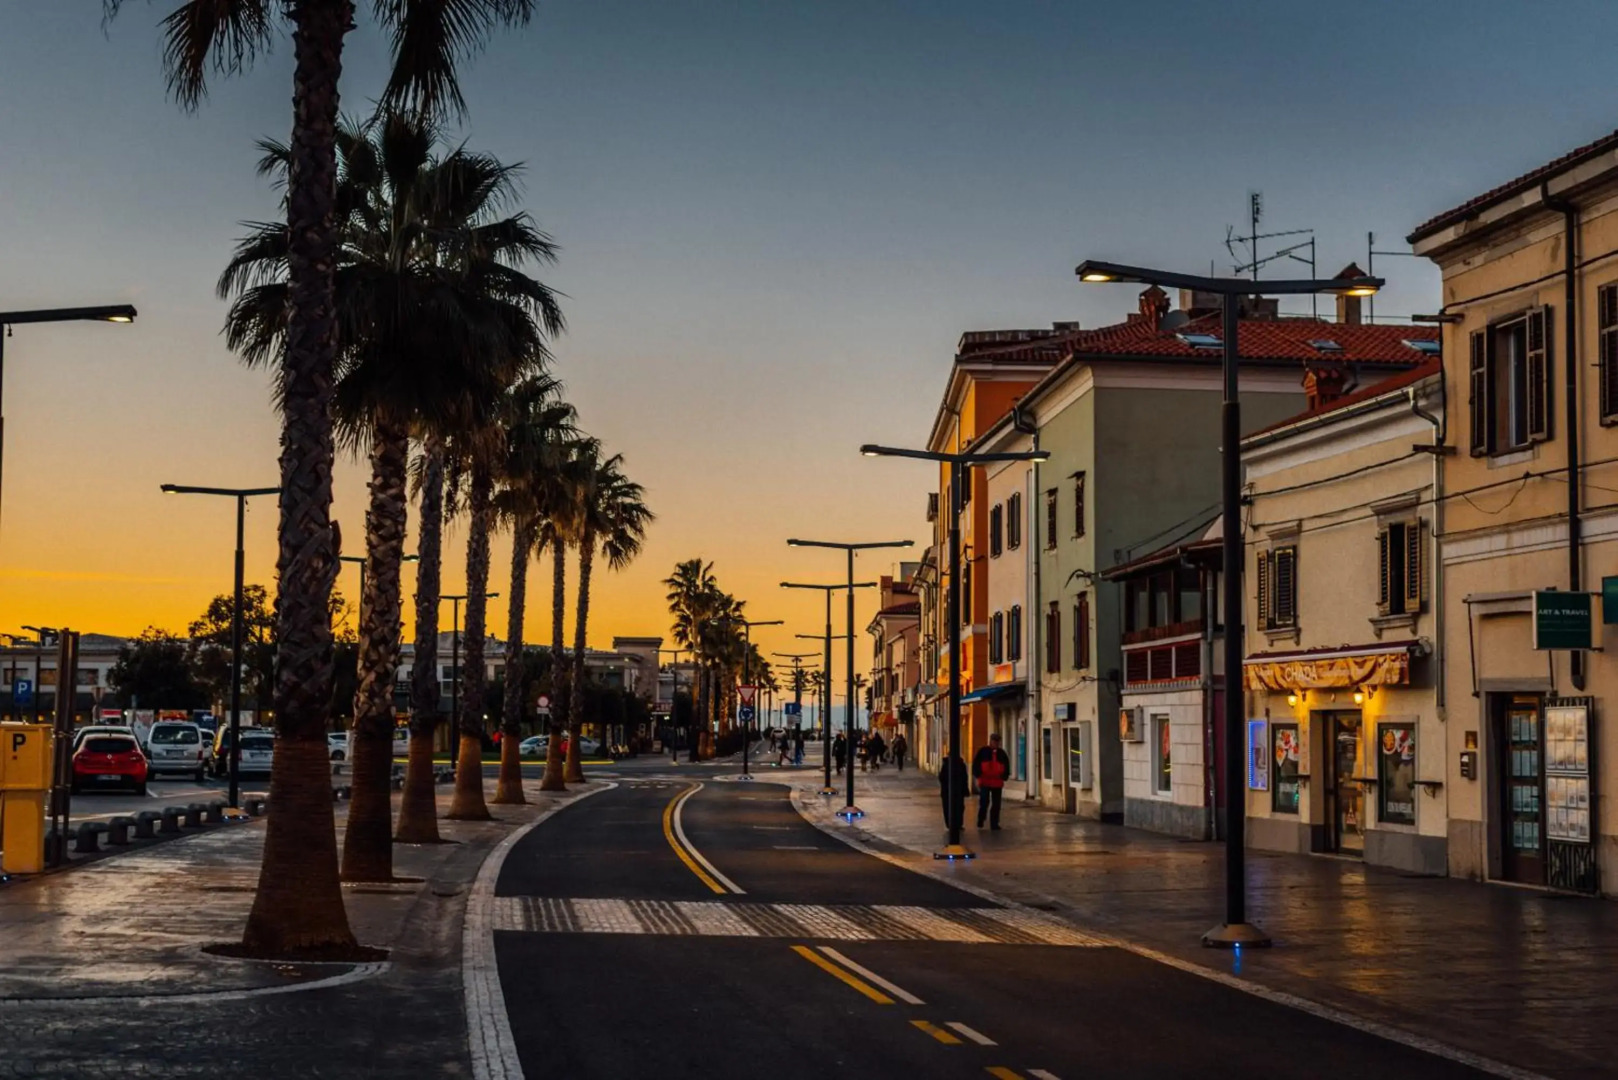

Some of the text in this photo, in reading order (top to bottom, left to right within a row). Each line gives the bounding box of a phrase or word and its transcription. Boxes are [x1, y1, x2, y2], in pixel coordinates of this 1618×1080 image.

[1538, 608, 1588, 617] ART & TRAVEL
[17, 681, 29, 695] P
[12, 732, 27, 753] P
